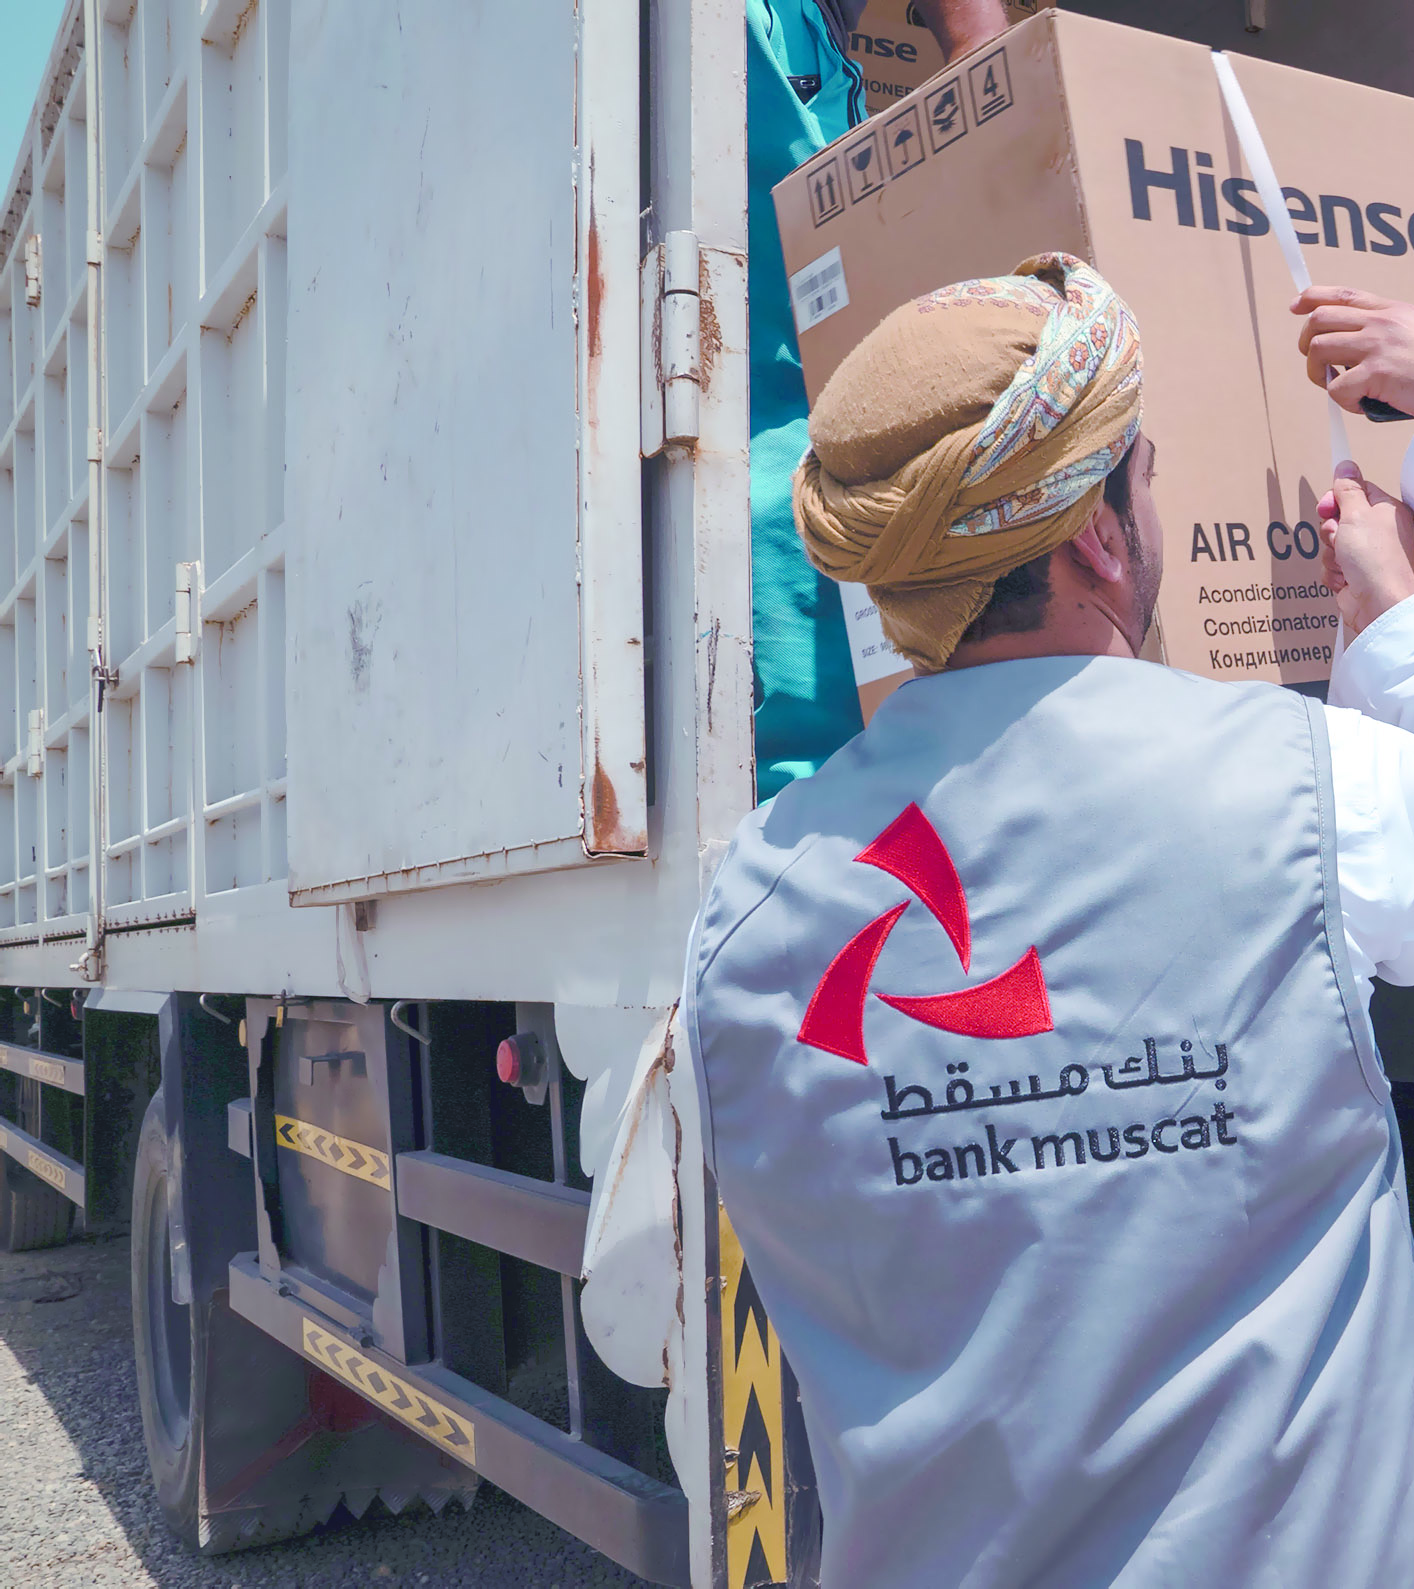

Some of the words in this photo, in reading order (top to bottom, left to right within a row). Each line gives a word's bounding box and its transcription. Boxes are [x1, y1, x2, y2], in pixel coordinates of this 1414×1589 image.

[1190, 522, 1255, 562] AIR
[1204, 613, 1339, 637] Condizionatore
[1209, 644, 1333, 670] Кондиционер
[1100, 1037, 1228, 1091] بنك
[881, 1061, 1090, 1120] مسقط
[887, 1124, 1020, 1186] bank
[1032, 1102, 1238, 1170] muscat
